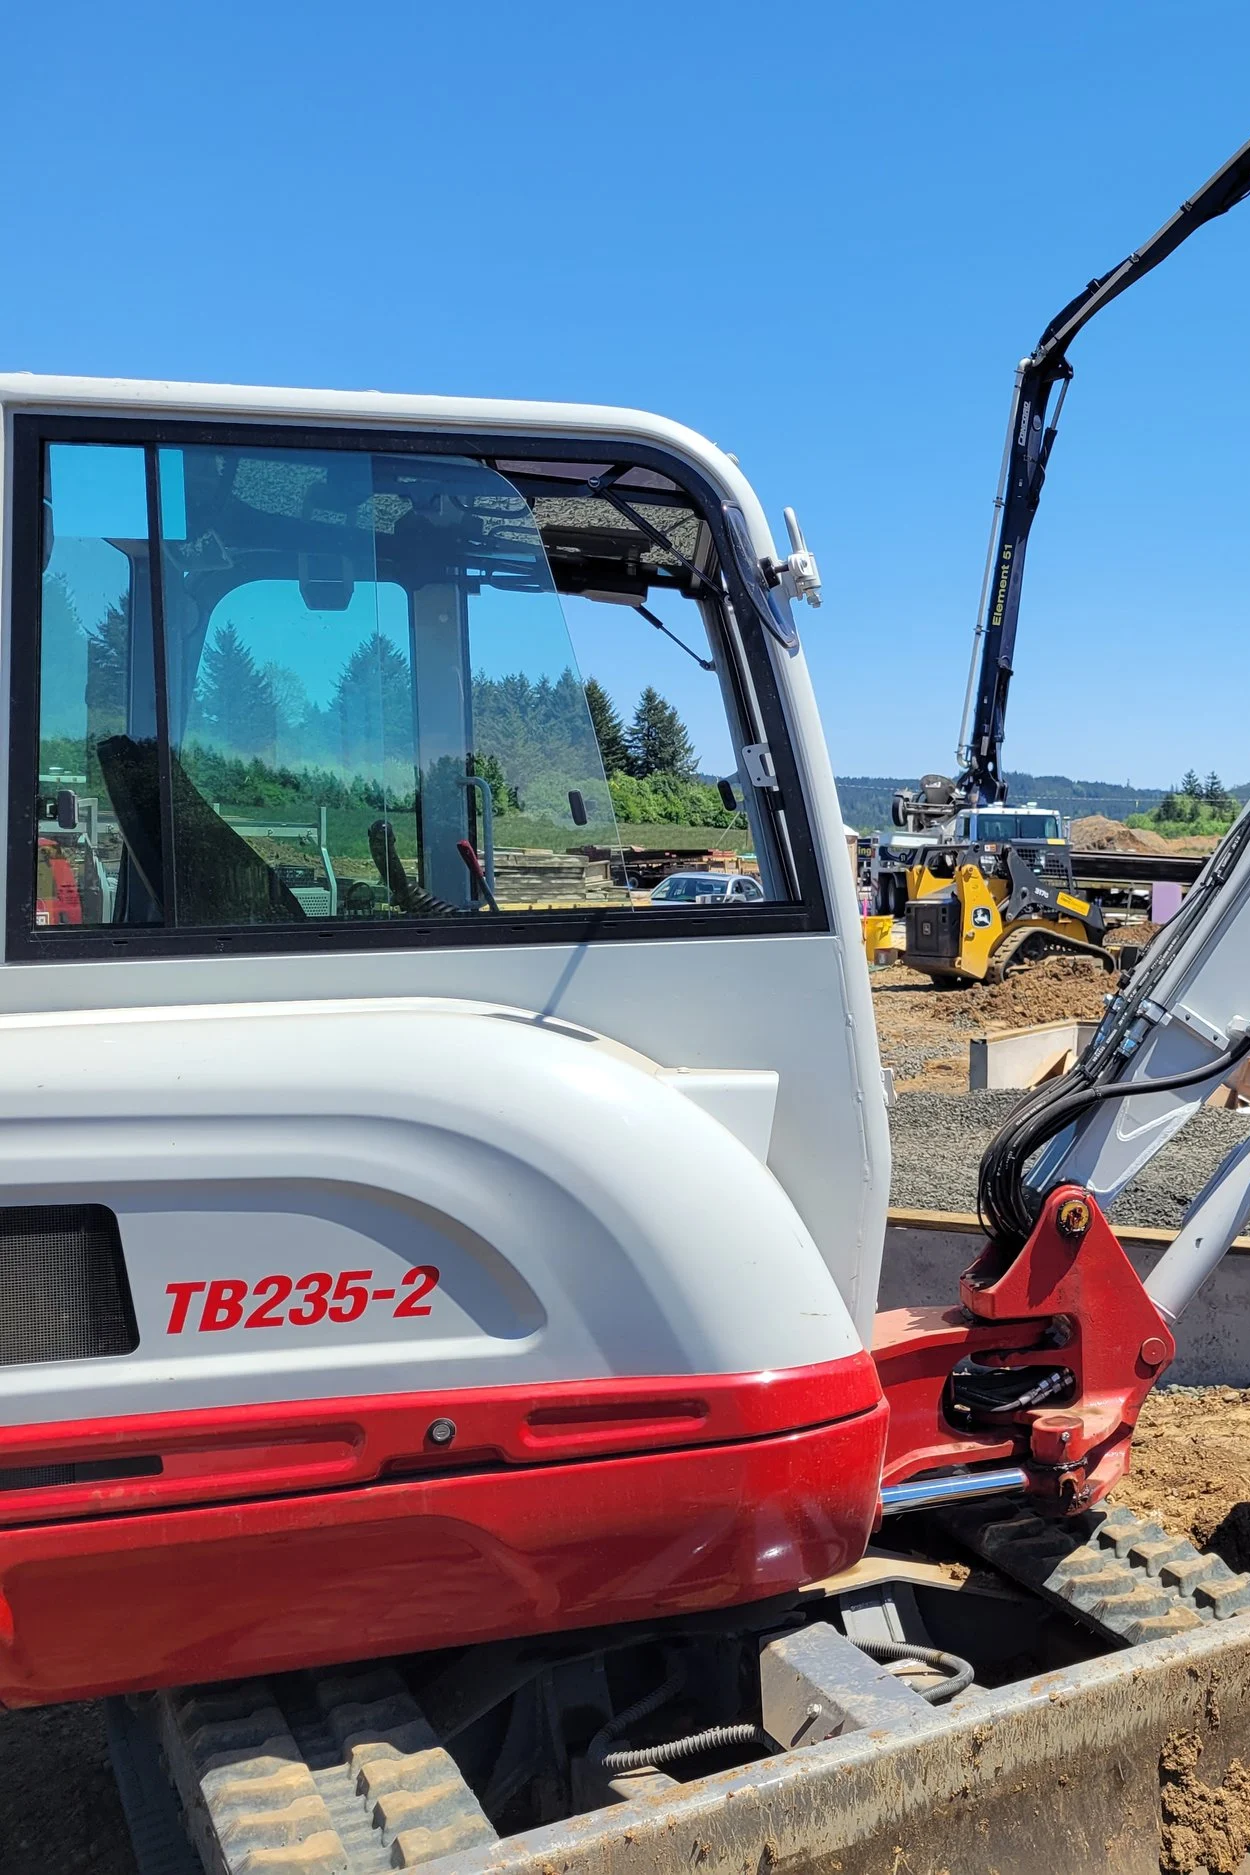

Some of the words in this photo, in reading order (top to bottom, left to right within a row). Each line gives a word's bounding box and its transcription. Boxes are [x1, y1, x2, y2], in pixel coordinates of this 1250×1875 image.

[1018, 401, 1031, 446] CONCORD
[992, 564, 1010, 626] Element
[1002, 544, 1013, 560] 51
[164, 1264, 441, 1335] TB235-2
